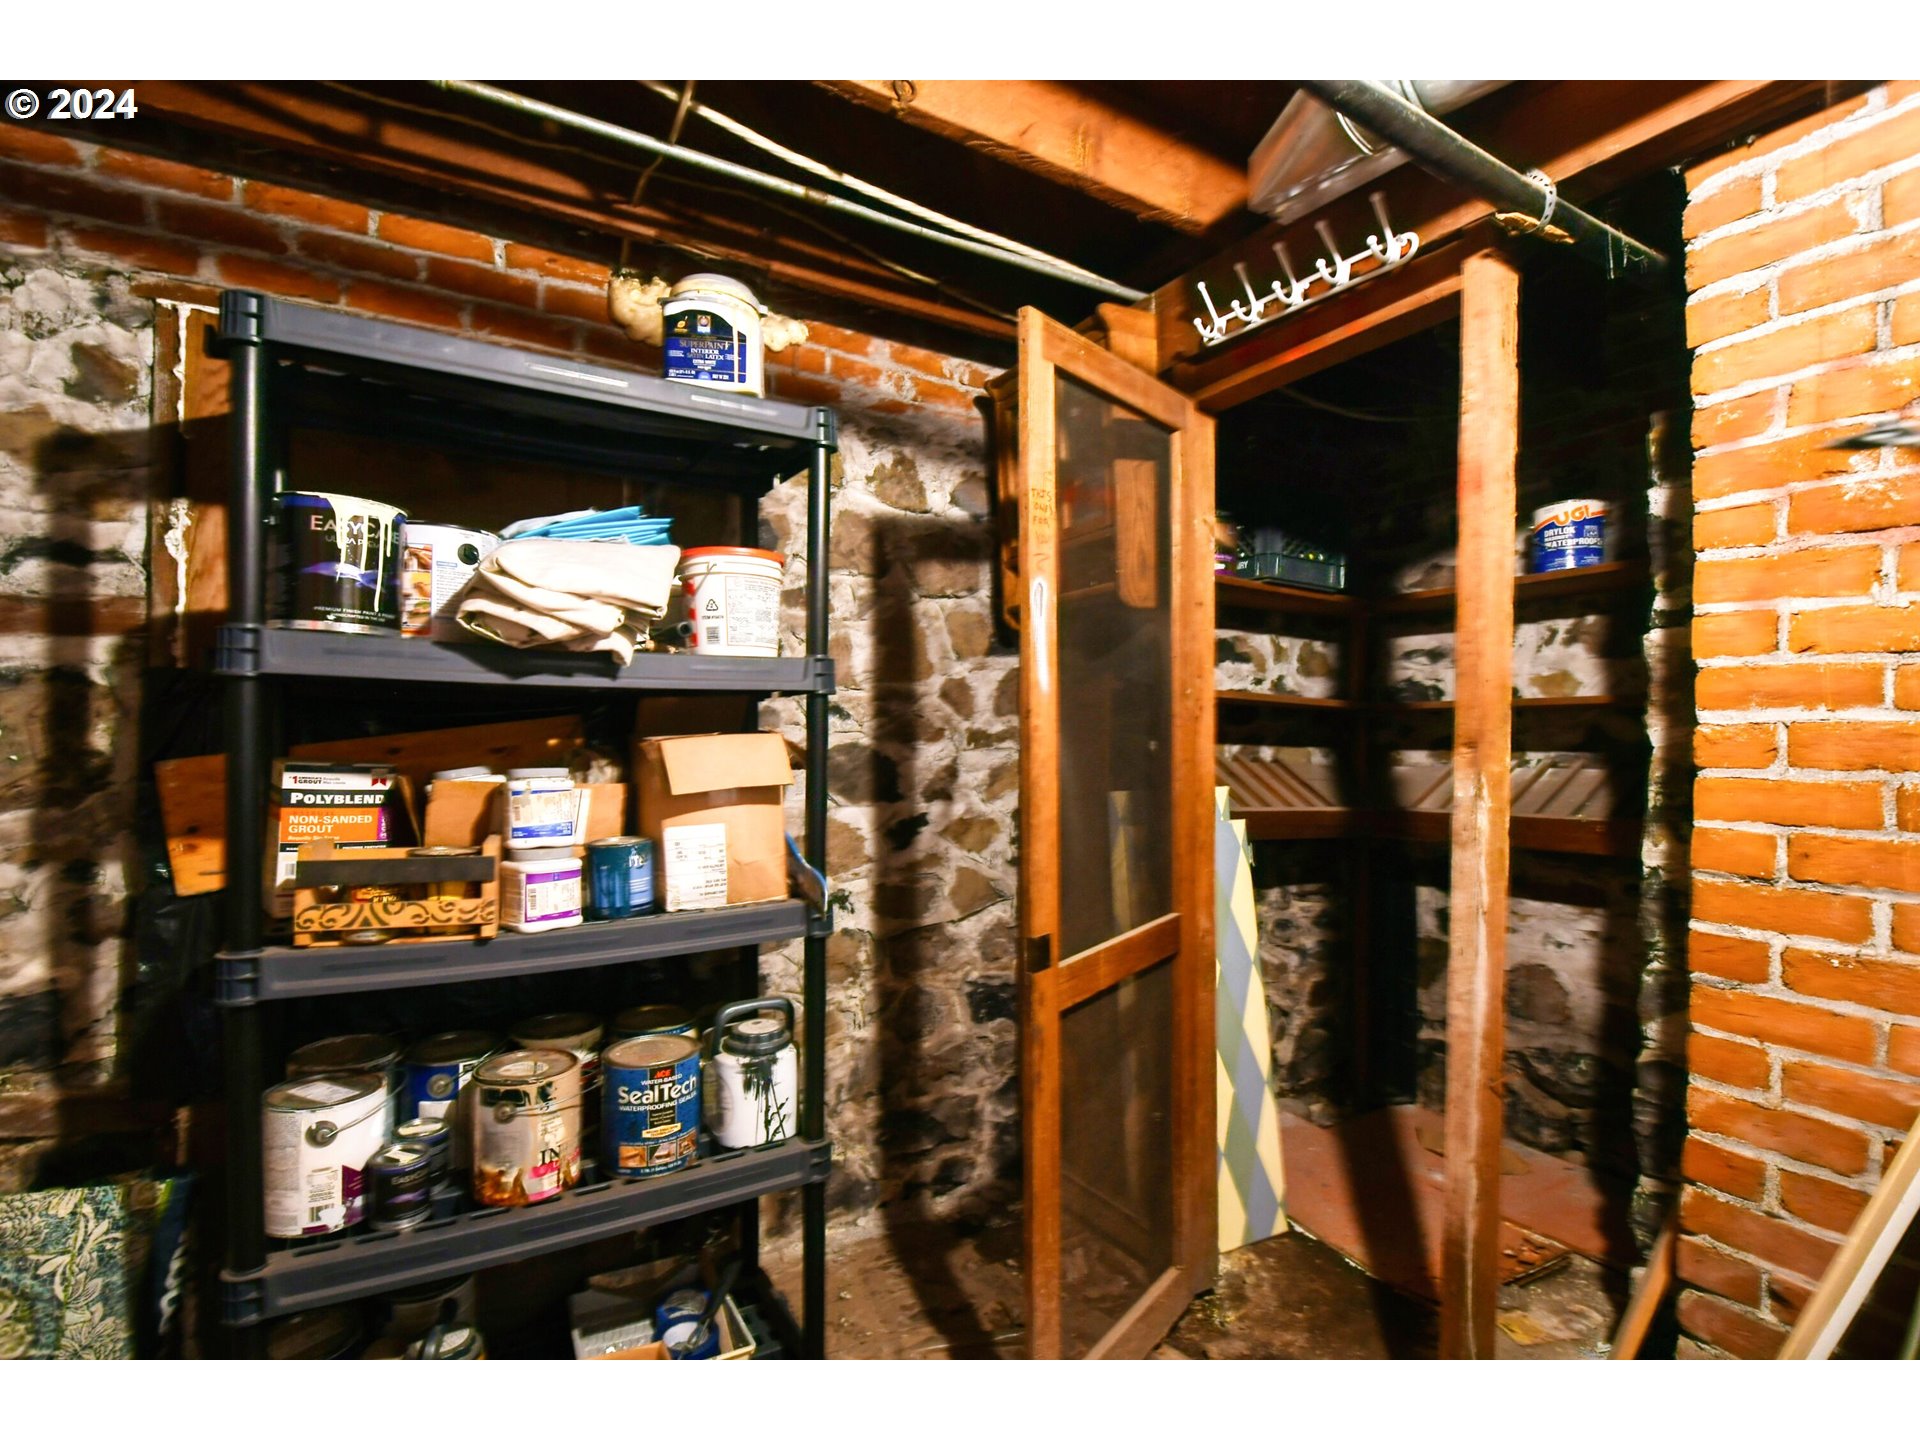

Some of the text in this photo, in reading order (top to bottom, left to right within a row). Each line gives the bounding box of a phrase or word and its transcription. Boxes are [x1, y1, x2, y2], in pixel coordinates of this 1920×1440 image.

[705, 353, 724, 361] LATEX
[1543, 526, 1576, 538] DRYLOK
[290, 792, 384, 804] POLYBLEND
[288, 815, 372, 824] NON-SANDED
[288, 824, 333, 834] GROUT
[640, 1073, 683, 1086] WATER-BASED
[655, 1069, 672, 1078] ACE
[617, 1075, 697, 1105] SealTech
[619, 1099, 678, 1112] WATERPROOFING
